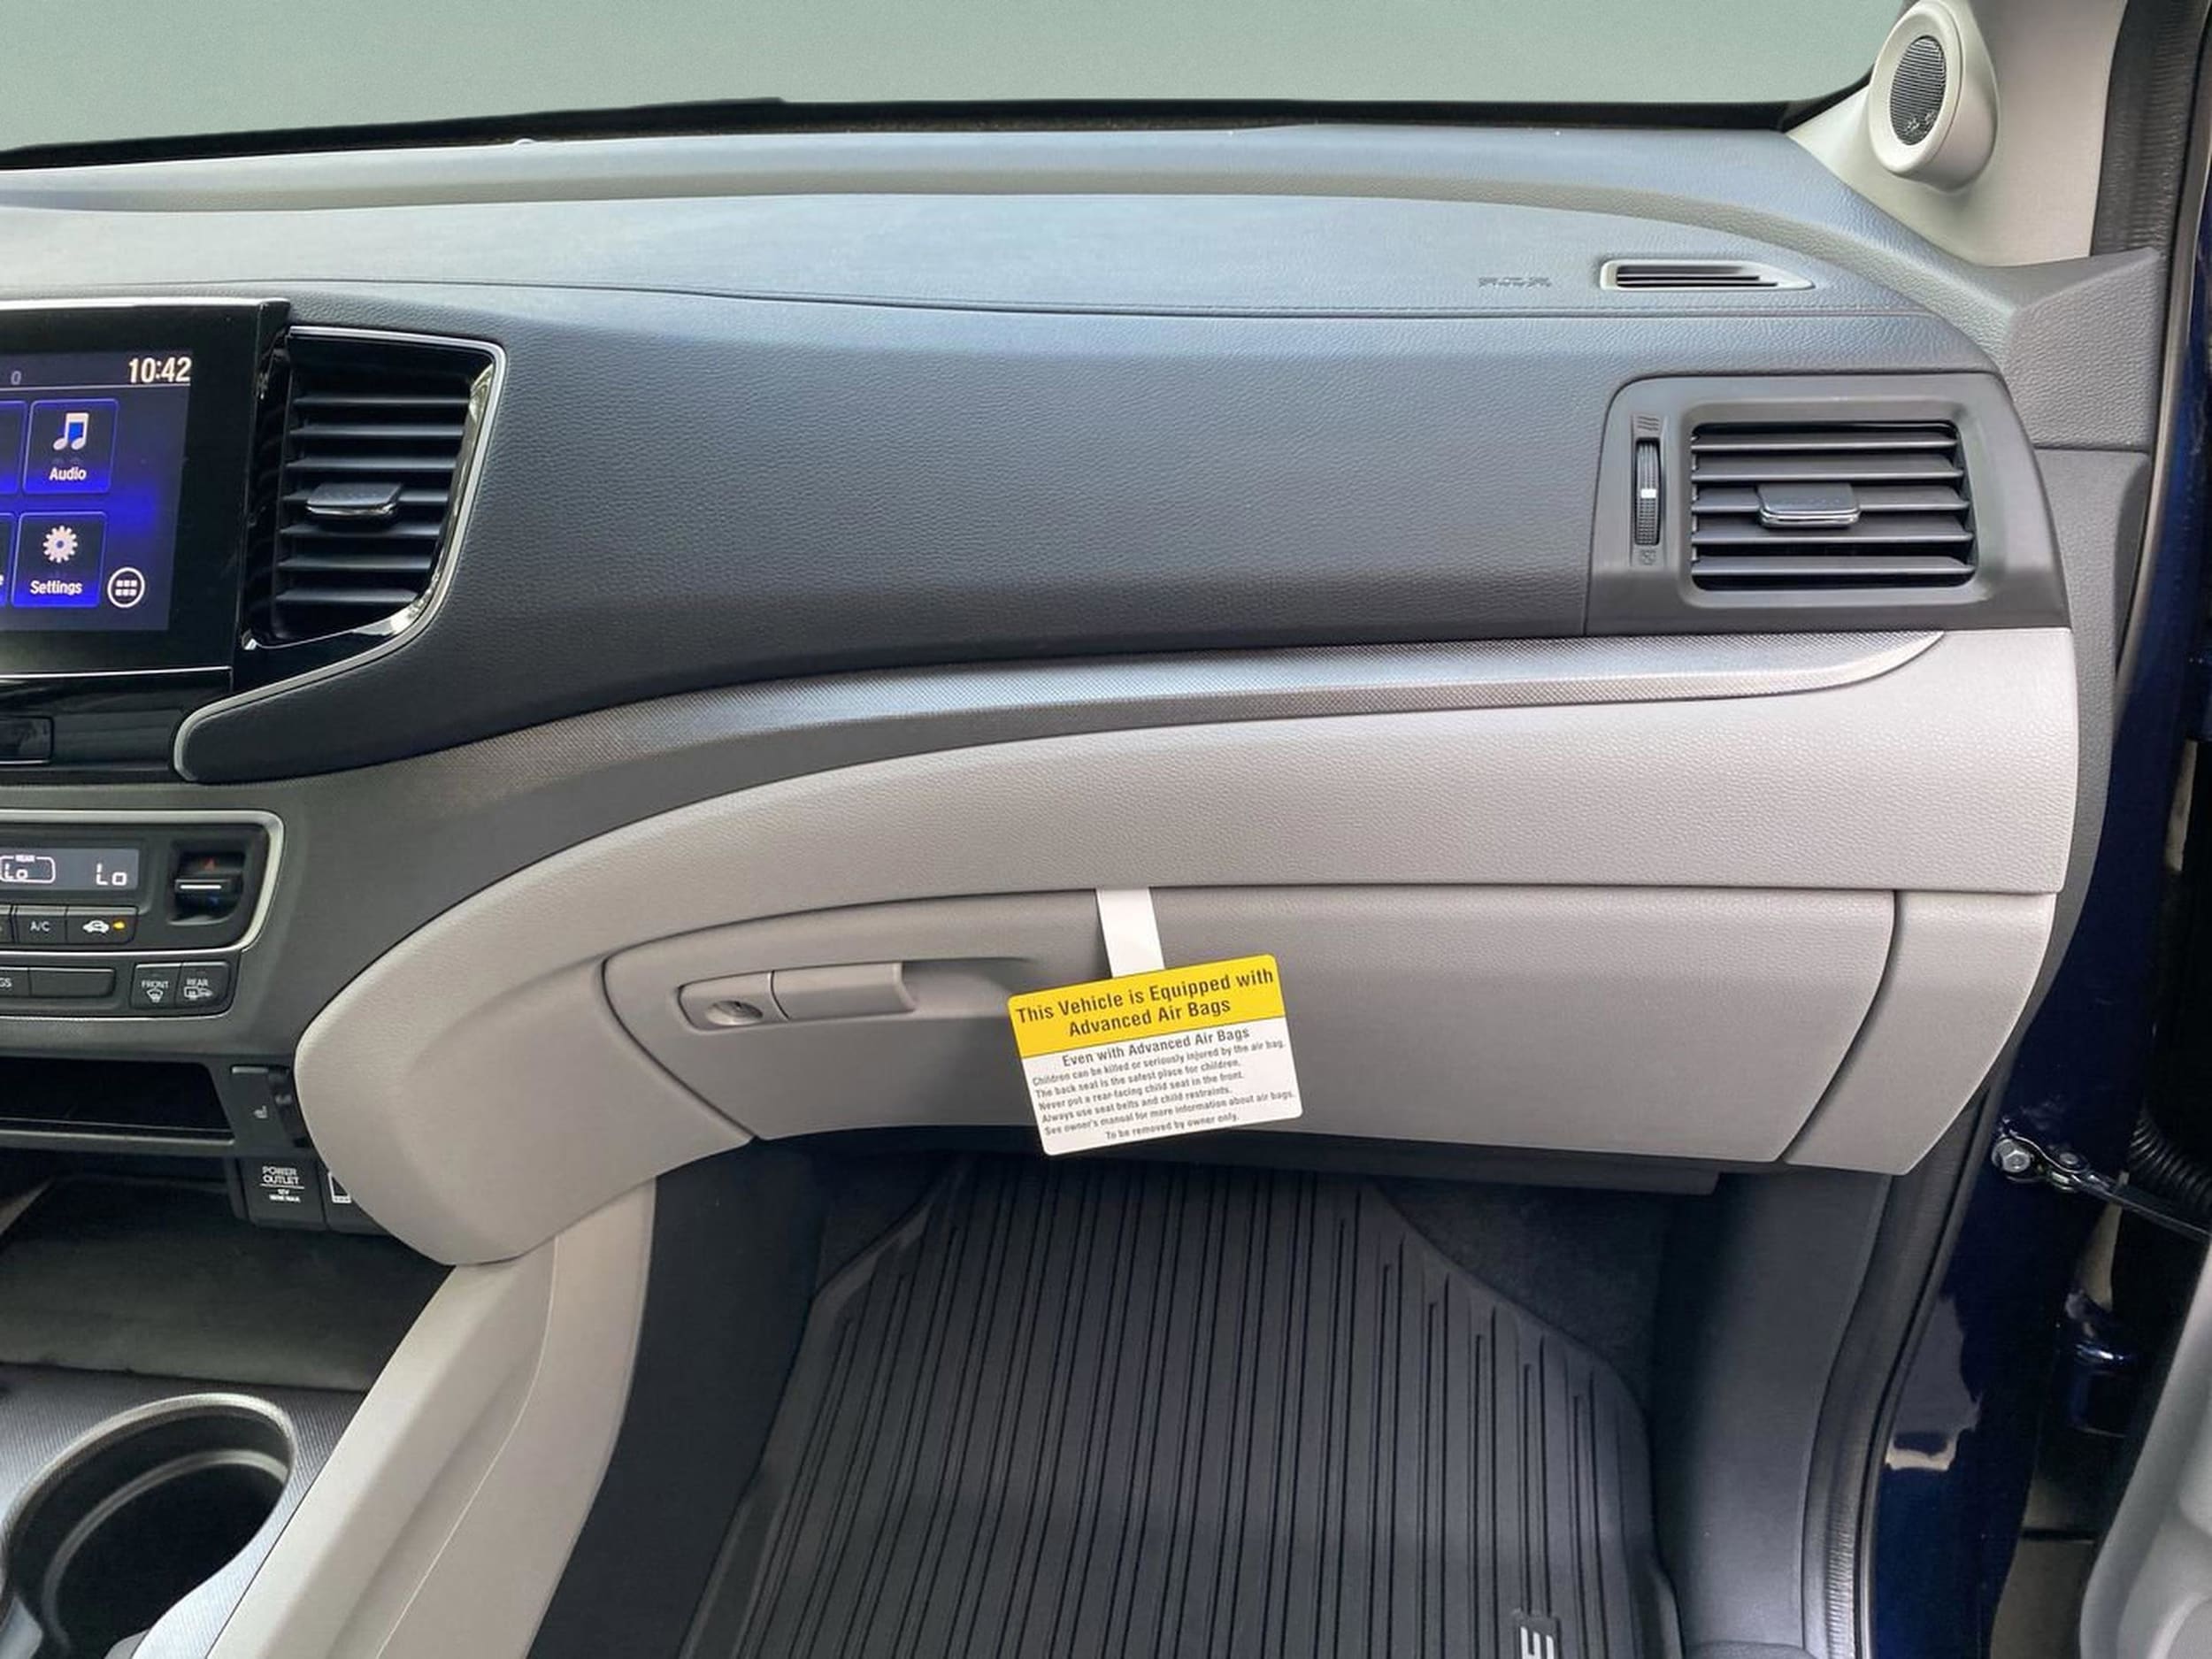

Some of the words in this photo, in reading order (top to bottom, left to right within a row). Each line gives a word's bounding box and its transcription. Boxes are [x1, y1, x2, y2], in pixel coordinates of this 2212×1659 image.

[128, 357, 192, 383] 10:42
[49, 466, 88, 482] Audio
[30, 580, 83, 595] Settings
[15, 854, 35, 863] REAR
[29, 921, 50, 932] A/C
[141, 979, 169, 988] FRONT
[186, 978, 209, 987] REAR
[1015, 1004, 1054, 1023] This
[1057, 993, 1123, 1016] Vehicle
[1127, 989, 1144, 1004] is
[1148, 974, 1230, 1002] Equipped
[1235, 968, 1273, 987] with
[1069, 1009, 1151, 1037] Advanced
[1158, 1004, 1181, 1022] Air
[1187, 1000, 1230, 1017] Bags
[1061, 1053, 1094, 1066] Even
[1096, 1046, 1125, 1060] with
[1128, 1035, 1191, 1056] Advanced
[1194, 1033, 1212, 1045] Air
[1216, 1027, 1249, 1041] Bags
[1032, 1072, 1071, 1086] Children
[1071, 1070, 1088, 1079] can
[1089, 1067, 1102, 1076] be
[1103, 1062, 1129, 1073] killed
[1142, 1054, 1184, 1067] seriously
[1186, 1047, 1218, 1061] injured
[1220, 1047, 1231, 1056] by
[1233, 1044, 1248, 1053] the
[1250, 1041, 1263, 1051] air
[1264, 1040, 1286, 1048] bag.
[1034, 1089, 1052, 1098] The
[1054, 1084, 1076, 1094] back
[1078, 1079, 1098, 1091] seat
[1127, 1071, 1156, 1083] safest
[1156, 1068, 1183, 1079] place
[1200, 1059, 1240, 1071] children.
[1038, 1100, 1065, 1110] Never
[1067, 1095, 1083, 1107] put
[1092, 1087, 1142, 1102] rear-facing
[1144, 1081, 1167, 1093] child
[1169, 1079, 1189, 1089] seat
[1202, 1075, 1217, 1084] the
[1041, 1111, 1074, 1123] Always
[1094, 1103, 1114, 1114] seat
[1116, 1100, 1139, 1110] belts
[1141, 1095, 1158, 1106] and
[1160, 1092, 1183, 1103] child
[1185, 1086, 1232, 1100] restraints.
[1044, 1125, 1062, 1135] See
[1064, 1118, 1098, 1132] owner's
[1099, 1112, 1133, 1125] manual
[1134, 1111, 1148, 1120] for
[1149, 1108, 1172, 1117] more
[1174, 1100, 1227, 1113] information
[1228, 1094, 1254, 1106] about
[1256, 1093, 1268, 1102] air
[1270, 1090, 1294, 1100] bags.
[1132, 1121, 1171, 1135] removed
[1173, 1120, 1184, 1129] by
[1187, 1116, 1215, 1126] owner
[1217, 1111, 1239, 1122] only.
[262, 1166, 296, 1175] POWER
[263, 1174, 299, 1184] OUTLET
